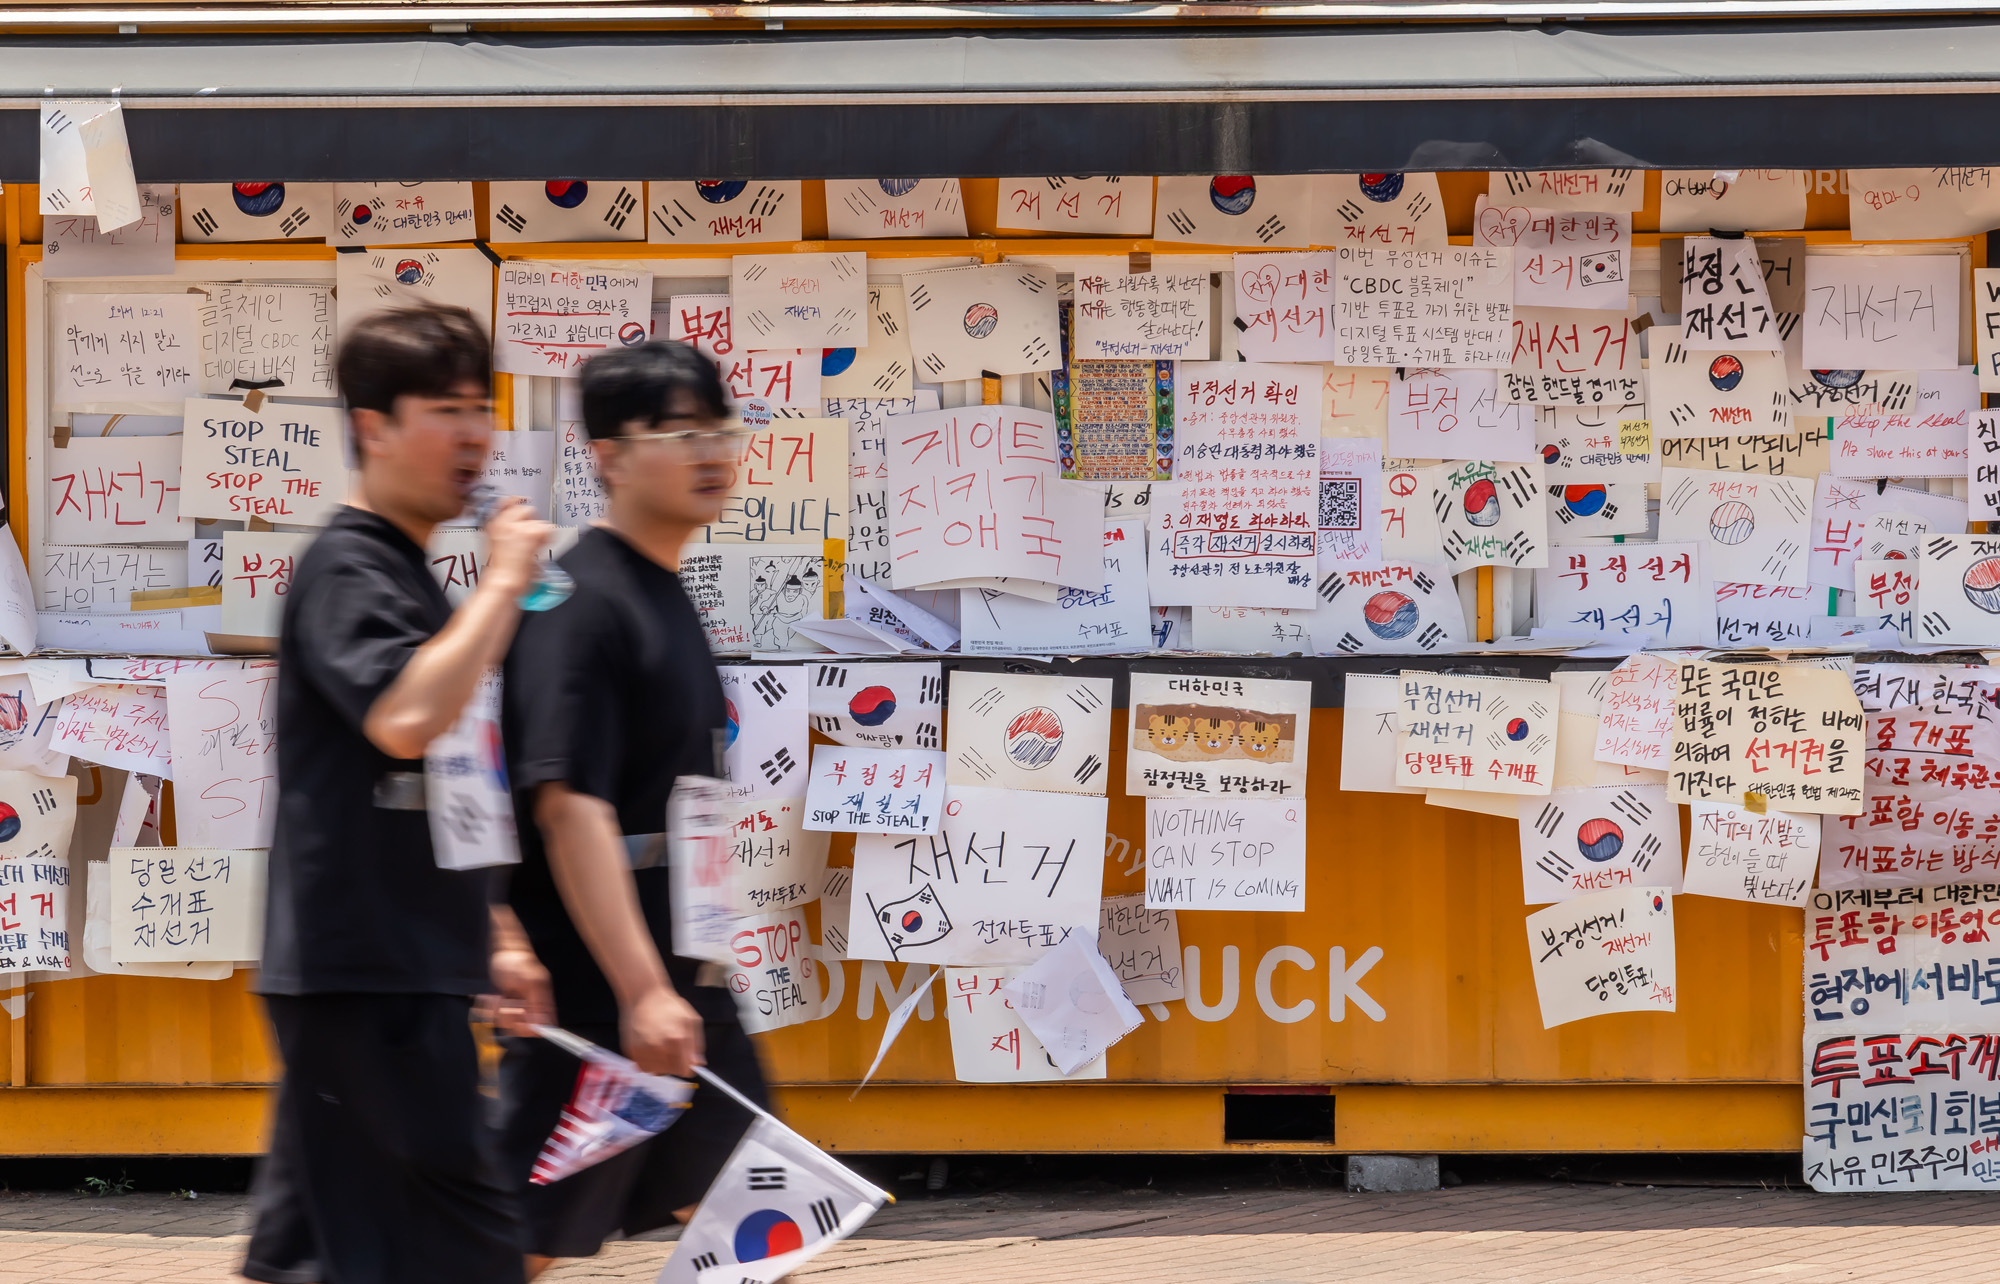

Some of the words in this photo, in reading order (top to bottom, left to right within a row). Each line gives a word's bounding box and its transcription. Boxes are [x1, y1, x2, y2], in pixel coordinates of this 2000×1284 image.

[1539, 173, 1598, 195] 재선거
[395, 195, 425, 210] 자유
[1010, 188, 1121, 220] 재선거
[393, 211, 440, 229] 대한민국
[708, 216, 762, 238] 재선거
[880, 209, 925, 229] 재선거
[1488, 218, 1521, 239] 자유
[1532, 217, 1618, 244] 대한민국
[1344, 225, 1416, 245] 재선거
[1340, 247, 1374, 267] 이번
[1454, 251, 1498, 268] 이슈는
[504, 270, 545, 287] 미래의
[780, 277, 821, 295] 부정선거
[1079, 275, 1114, 295] 자유는
[1117, 275, 1160, 293] 외칠수록
[142, 307, 163, 318] 12:21
[198, 288, 283, 327] 블록체인
[506, 293, 552, 312] 부끄럽지
[556, 296, 580, 316] 않은
[586, 299, 629, 317] 역사를
[784, 305, 821, 320] 재선거
[1080, 300, 1116, 320] 자유는
[1341, 302, 1370, 321] 기반
[1379, 301, 1418, 320] 투표로
[1425, 303, 1448, 318] 가기
[1453, 303, 1480, 322] 위한
[1486, 304, 1511, 323] 발판
[1811, 285, 1935, 342] 재선거
[507, 324, 557, 342] 가르치고
[565, 325, 615, 343] 싶습니다
[1137, 320, 1203, 341] 살아난다!
[1248, 305, 1326, 342] 재선거
[1340, 324, 1387, 342] 디지털
[1393, 326, 1416, 342] 투표
[1422, 327, 1458, 343] 시스템
[67, 324, 109, 355] 악에게
[120, 330, 145, 354] 지지
[154, 329, 181, 352] 말고
[202, 325, 253, 354] 디지털
[260, 333, 299, 350] CBDC
[1511, 318, 1629, 373] 재선거
[70, 364, 111, 387] 선으로
[120, 363, 145, 387] 악을
[156, 366, 190, 387] 이기라
[204, 356, 257, 380] 데이터
[1187, 379, 1256, 406] 부정선거
[1263, 380, 1299, 406] 확인
[1504, 373, 1538, 401] 잠실
[1542, 377, 1584, 405] 핸드볼
[1586, 378, 1638, 401] 경기장
[755, 410, 771, 418] Steal
[827, 396, 917, 420] 부정선거
[1709, 406, 1752, 423] 재선거
[203, 419, 264, 441] STOP
[280, 422, 321, 447] THE
[743, 418, 752, 426] My
[1621, 421, 1650, 432] 재선거
[1883, 414, 1911, 431] the
[1183, 443, 1222, 460] 이승만
[1224, 443, 1262, 460] 대통령
[1265, 443, 1292, 459] 하야
[1584, 437, 1612, 448] 자유
[1620, 434, 1650, 448] 부정선거
[1867, 446, 1893, 459] share
[1899, 446, 1921, 459] this
[1926, 446, 1936, 457] at
[225, 445, 301, 472] STEAL
[1580, 454, 1622, 465] 대한민국
[51, 461, 181, 526] 재선거
[206, 472, 263, 491] STOP
[282, 479, 322, 498] THE
[1709, 481, 1758, 499] 재선거
[229, 495, 293, 515] STEAL
[1163, 513, 1174, 529] 3.
[1179, 512, 1241, 530] 이재명도
[1875, 517, 1927, 536] 재선거
[943, 513, 1062, 576] 애국
[1177, 534, 1206, 554] 즉각
[1210, 534, 1257, 554] 재선거
[1464, 534, 1508, 559] 재선거
[45, 552, 170, 587] 재선거는
[1169, 562, 1224, 577] 중앙선관위
[1228, 562, 1240, 575] 전
[1347, 565, 1414, 587] 재선거
[1558, 553, 1691, 590] 부정선거
[1078, 621, 1127, 640] 수개표
[1568, 597, 1673, 639] 재선거
[1169, 679, 1244, 697] 대한민국
[1681, 665, 1710, 697] 모든
[1721, 669, 1783, 701] 국민은
[1404, 683, 1481, 714] 부정선거
[1678, 702, 1733, 738] 법률이
[1748, 705, 1806, 734] 정하는
[1822, 711, 1863, 734] 바에
[1408, 720, 1474, 746] 재선거
[1910, 721, 1974, 756] 개표
[1675, 741, 1731, 765] 의하여
[1745, 737, 1849, 776] 선거권을
[824, 760, 933, 789] 부정선거
[1405, 753, 1475, 777] 당일투표
[1488, 759, 1544, 786] 수개표
[1143, 770, 1210, 793] 참정권을
[1219, 774, 1291, 795] 보장하라
[1748, 783, 1797, 800] 대한민국
[1801, 784, 1822, 801] 헌법
[1826, 786, 1861, 802] 제24조
[812, 810, 840, 824] STOP
[846, 811, 871, 825] THE
[876, 814, 929, 831] STEAL!
[1152, 809, 1245, 840] NOTHING
[1699, 810, 1753, 842] 자유의
[1758, 817, 1810, 850] 깃발은
[1933, 808, 1974, 839] 이동
[727, 837, 790, 867] 재선거
[894, 830, 1076, 898] 재선거
[1151, 843, 1196, 869] CAN
[1210, 840, 1275, 868] STOP
[1698, 844, 1741, 867] 당신이
[1766, 852, 1788, 873] 때
[1839, 843, 1944, 873] 개표하는
[130, 858, 177, 887] 당일
[184, 856, 231, 884] 선거
[1572, 868, 1633, 889] 재선거
[1208, 879, 1227, 901] IS
[1233, 881, 1299, 900] COMING
[1814, 887, 1923, 912] 이제부터
[131, 890, 214, 920] 수개표
[134, 917, 210, 948] 재선거
[730, 920, 801, 967] STOP
[1540, 908, 1625, 963] 부정선거!
[1809, 910, 1905, 961] 투표함
[766, 966, 790, 987] THE
[1584, 964, 1654, 1002] 당일투표!
[756, 984, 807, 1016] STEAL
[1809, 1157, 1866, 1186] 자유
[1872, 1145, 1968, 1186] 민주주의
